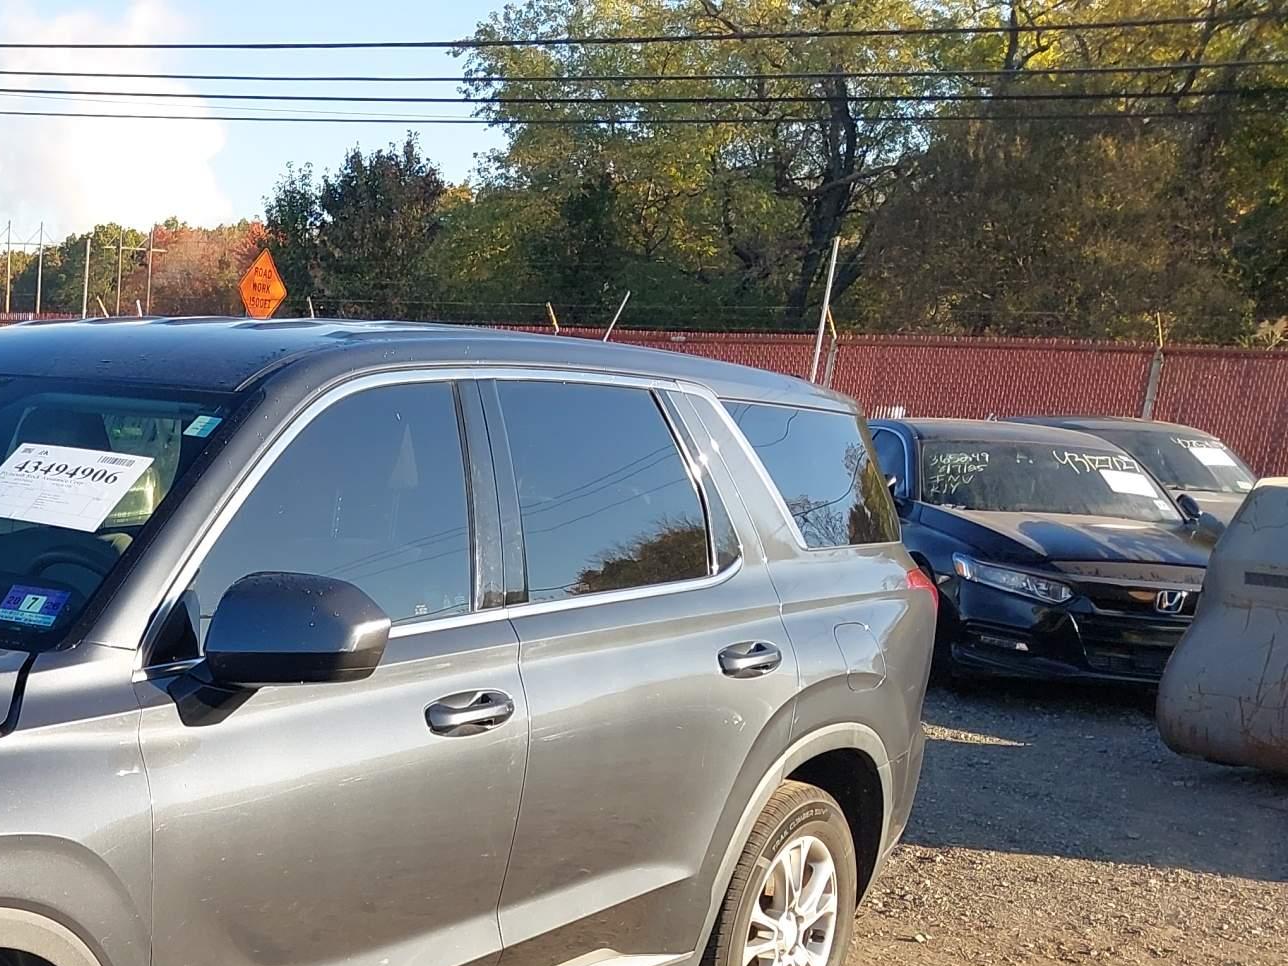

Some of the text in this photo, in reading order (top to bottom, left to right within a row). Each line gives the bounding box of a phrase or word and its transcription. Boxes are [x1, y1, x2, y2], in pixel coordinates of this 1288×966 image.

[254, 267, 273, 279] ROAD
[252, 281, 271, 294] WORK
[14, 459, 124, 484] 43494906
[26, 596, 40, 609] 7
